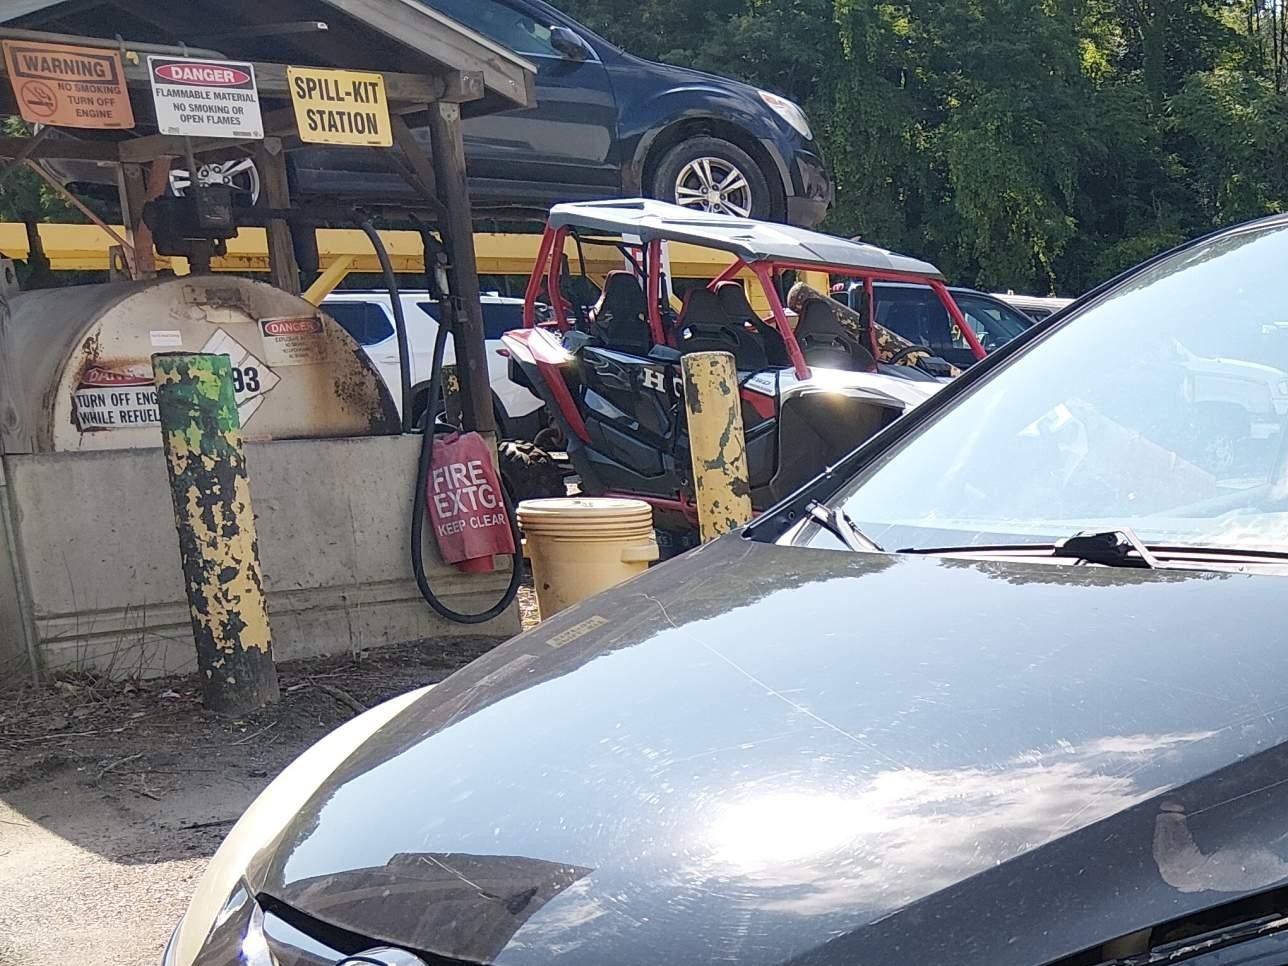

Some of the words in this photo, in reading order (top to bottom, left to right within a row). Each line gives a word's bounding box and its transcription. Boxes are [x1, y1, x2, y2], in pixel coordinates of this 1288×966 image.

[23, 54, 106, 78] WARNING
[170, 66, 235, 83] DANGER
[58, 82, 72, 92] NO
[75, 84, 121, 95] SMOKING
[156, 88, 211, 100] FLAMMABLE
[213, 92, 256, 103] MATERIAL
[295, 76, 379, 104] SPILL-KIT
[67, 95, 94, 106] TURN
[97, 97, 116, 107] OFF
[173, 103, 186, 112] NO
[189, 104, 230, 114] SMOKING
[232, 106, 244, 115] OR
[75, 108, 113, 119] ENGINE
[180, 115, 204, 124] OPEN
[207, 116, 241, 125] FLAMES
[306, 108, 379, 135] STATION
[76, 394, 106, 408] TURN
[110, 392, 131, 406] OFF
[79, 411, 115, 425] WHILE
[433, 460, 487, 494] FIRE
[434, 484, 503, 519] EXTG.
[438, 519, 466, 537] KEEP
[470, 513, 506, 529] CLEAR
